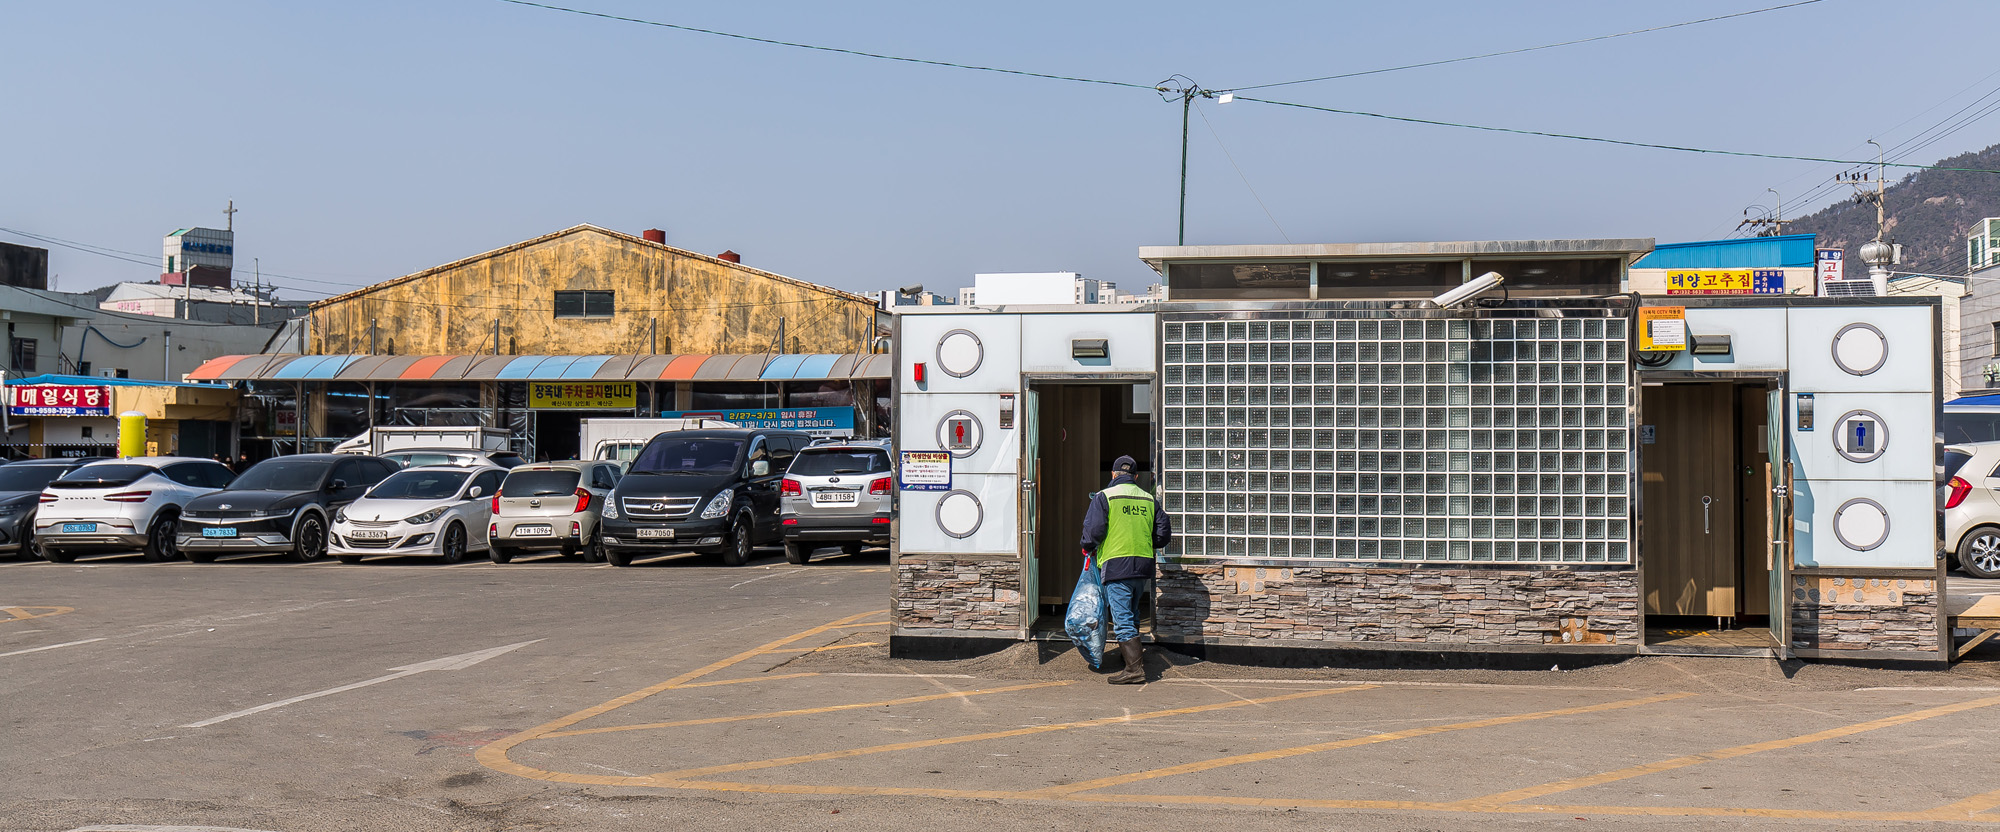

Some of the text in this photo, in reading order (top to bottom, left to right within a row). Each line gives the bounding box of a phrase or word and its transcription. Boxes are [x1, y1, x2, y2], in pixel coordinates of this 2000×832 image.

[1820, 251, 1842, 260] 태양
[535, 384, 632, 399] 장옥내 주차 금지합니다
[21, 388, 101, 406] 매일식당
[729, 410, 817, 420] 2/27~3/31 임시 휴장!
[763, 420, 778, 429] 다시
[780, 419, 795, 428] 찾아
[797, 419, 837, 428] 뵙겠습니다.
[61, 450, 87, 458] 비빔국수
